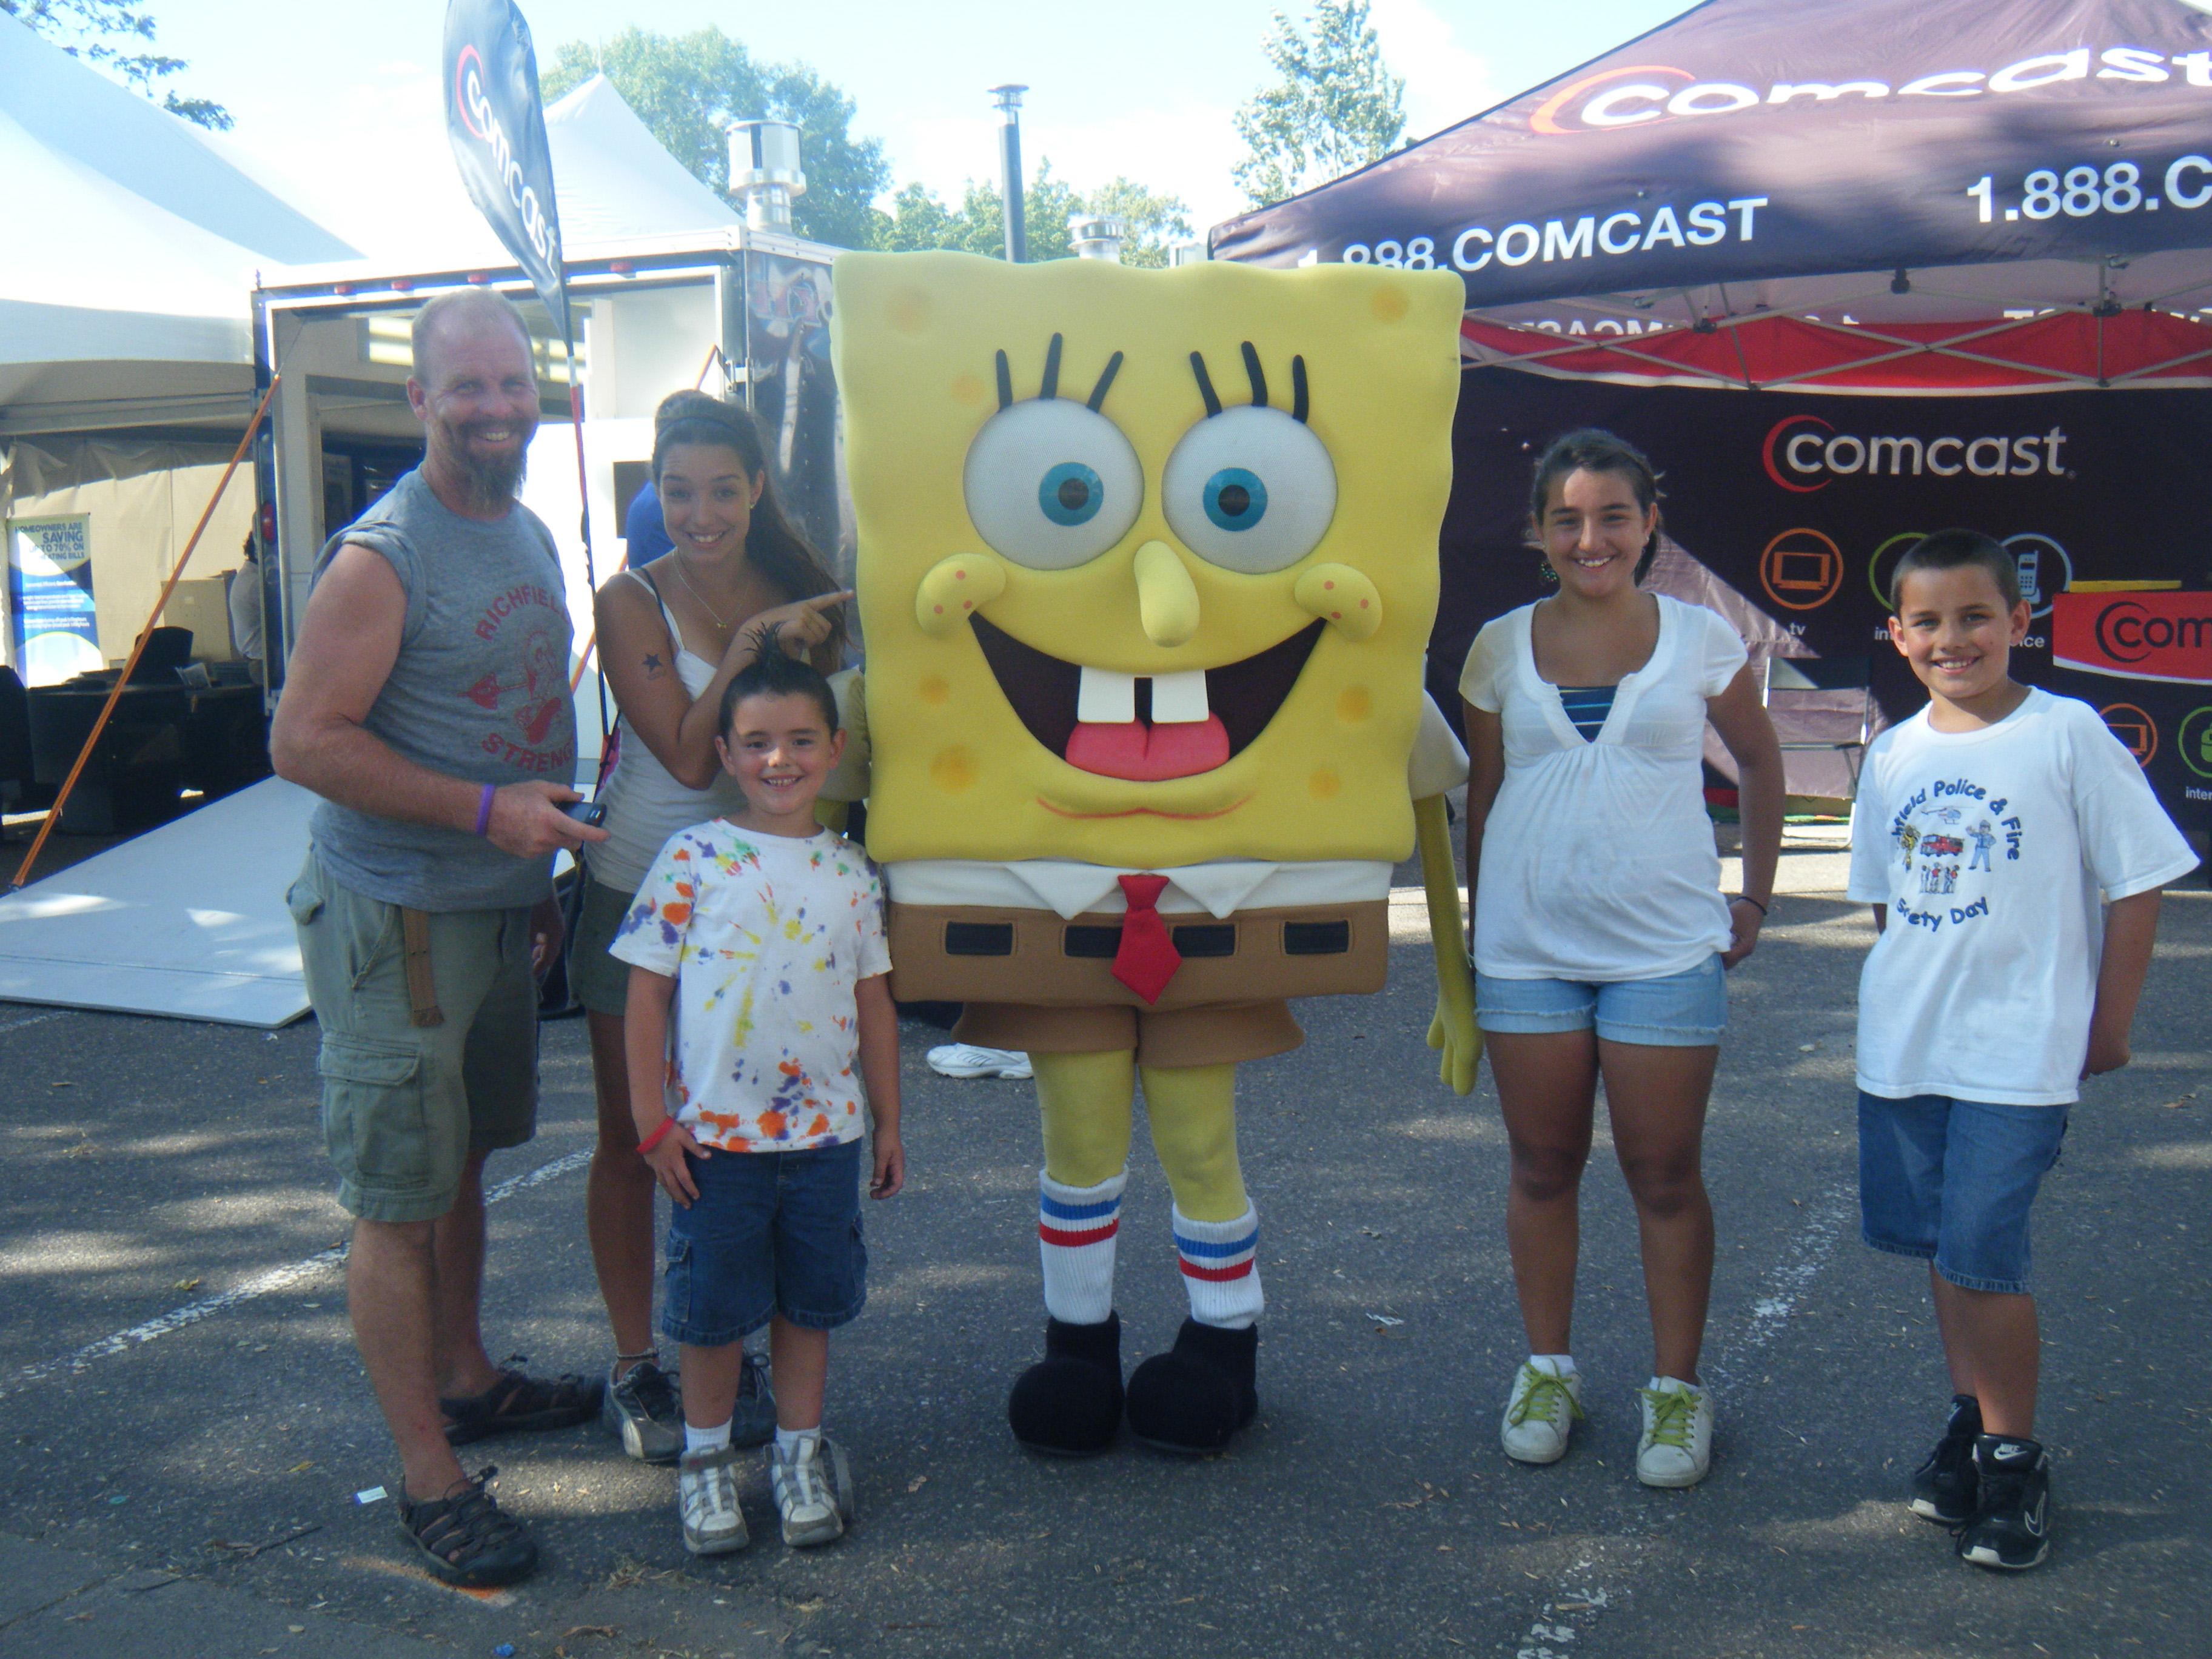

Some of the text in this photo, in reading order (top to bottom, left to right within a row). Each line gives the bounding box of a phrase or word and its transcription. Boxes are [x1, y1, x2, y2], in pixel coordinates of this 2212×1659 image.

[1580, 47, 2212, 126] comcast
[466, 68, 557, 280] comcast
[1297, 196, 1769, 272] 88.COMCAST
[1785, 426, 2068, 477] comcast
[41, 544, 53, 552] TO
[73, 542, 84, 551] ON
[42, 531, 83, 544] SAVING
[68, 522, 82, 531] ARE
[1789, 622, 1806, 636] tv
[1933, 778, 1987, 801] Police
[1989, 798, 2008, 816] &
[2001, 816, 2023, 860] Fire
[1896, 896, 1989, 933] Sety Day
